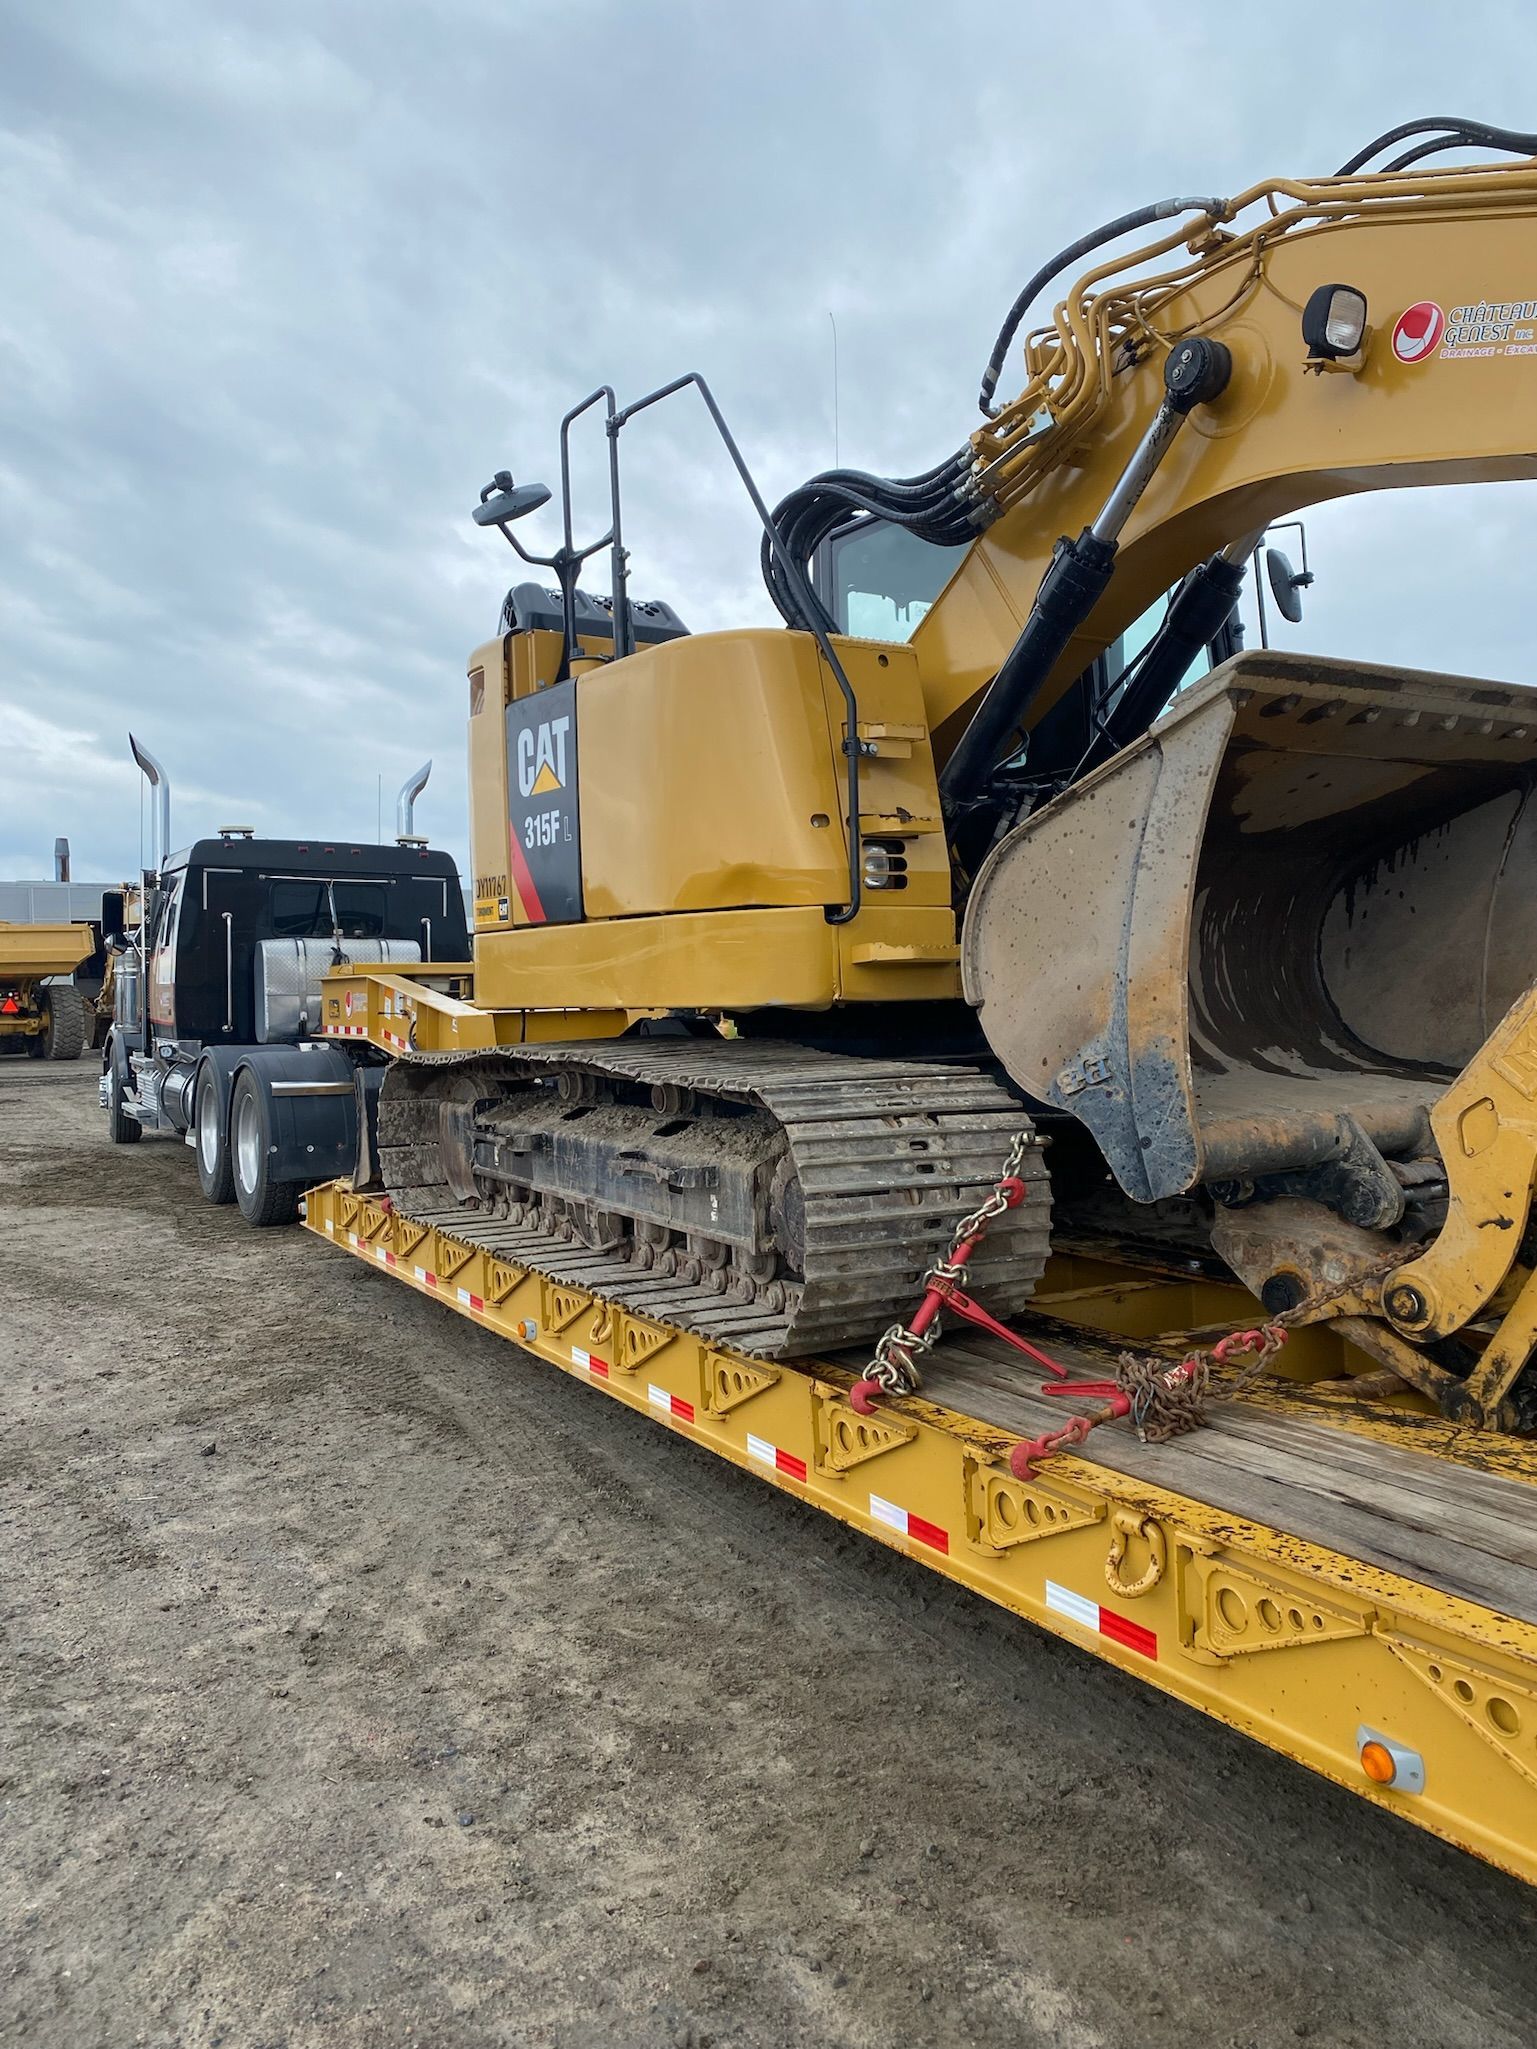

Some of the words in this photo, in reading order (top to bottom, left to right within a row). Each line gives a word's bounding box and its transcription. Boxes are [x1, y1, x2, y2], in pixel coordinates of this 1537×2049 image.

[1449, 301, 1537, 324] CHÂTEAU
[1444, 323, 1514, 347] GENEST
[1440, 347, 1494, 358] DRAINAGE
[517, 715, 569, 798] CAT
[524, 809, 560, 849] 315F
[563, 815, 572, 841] L
